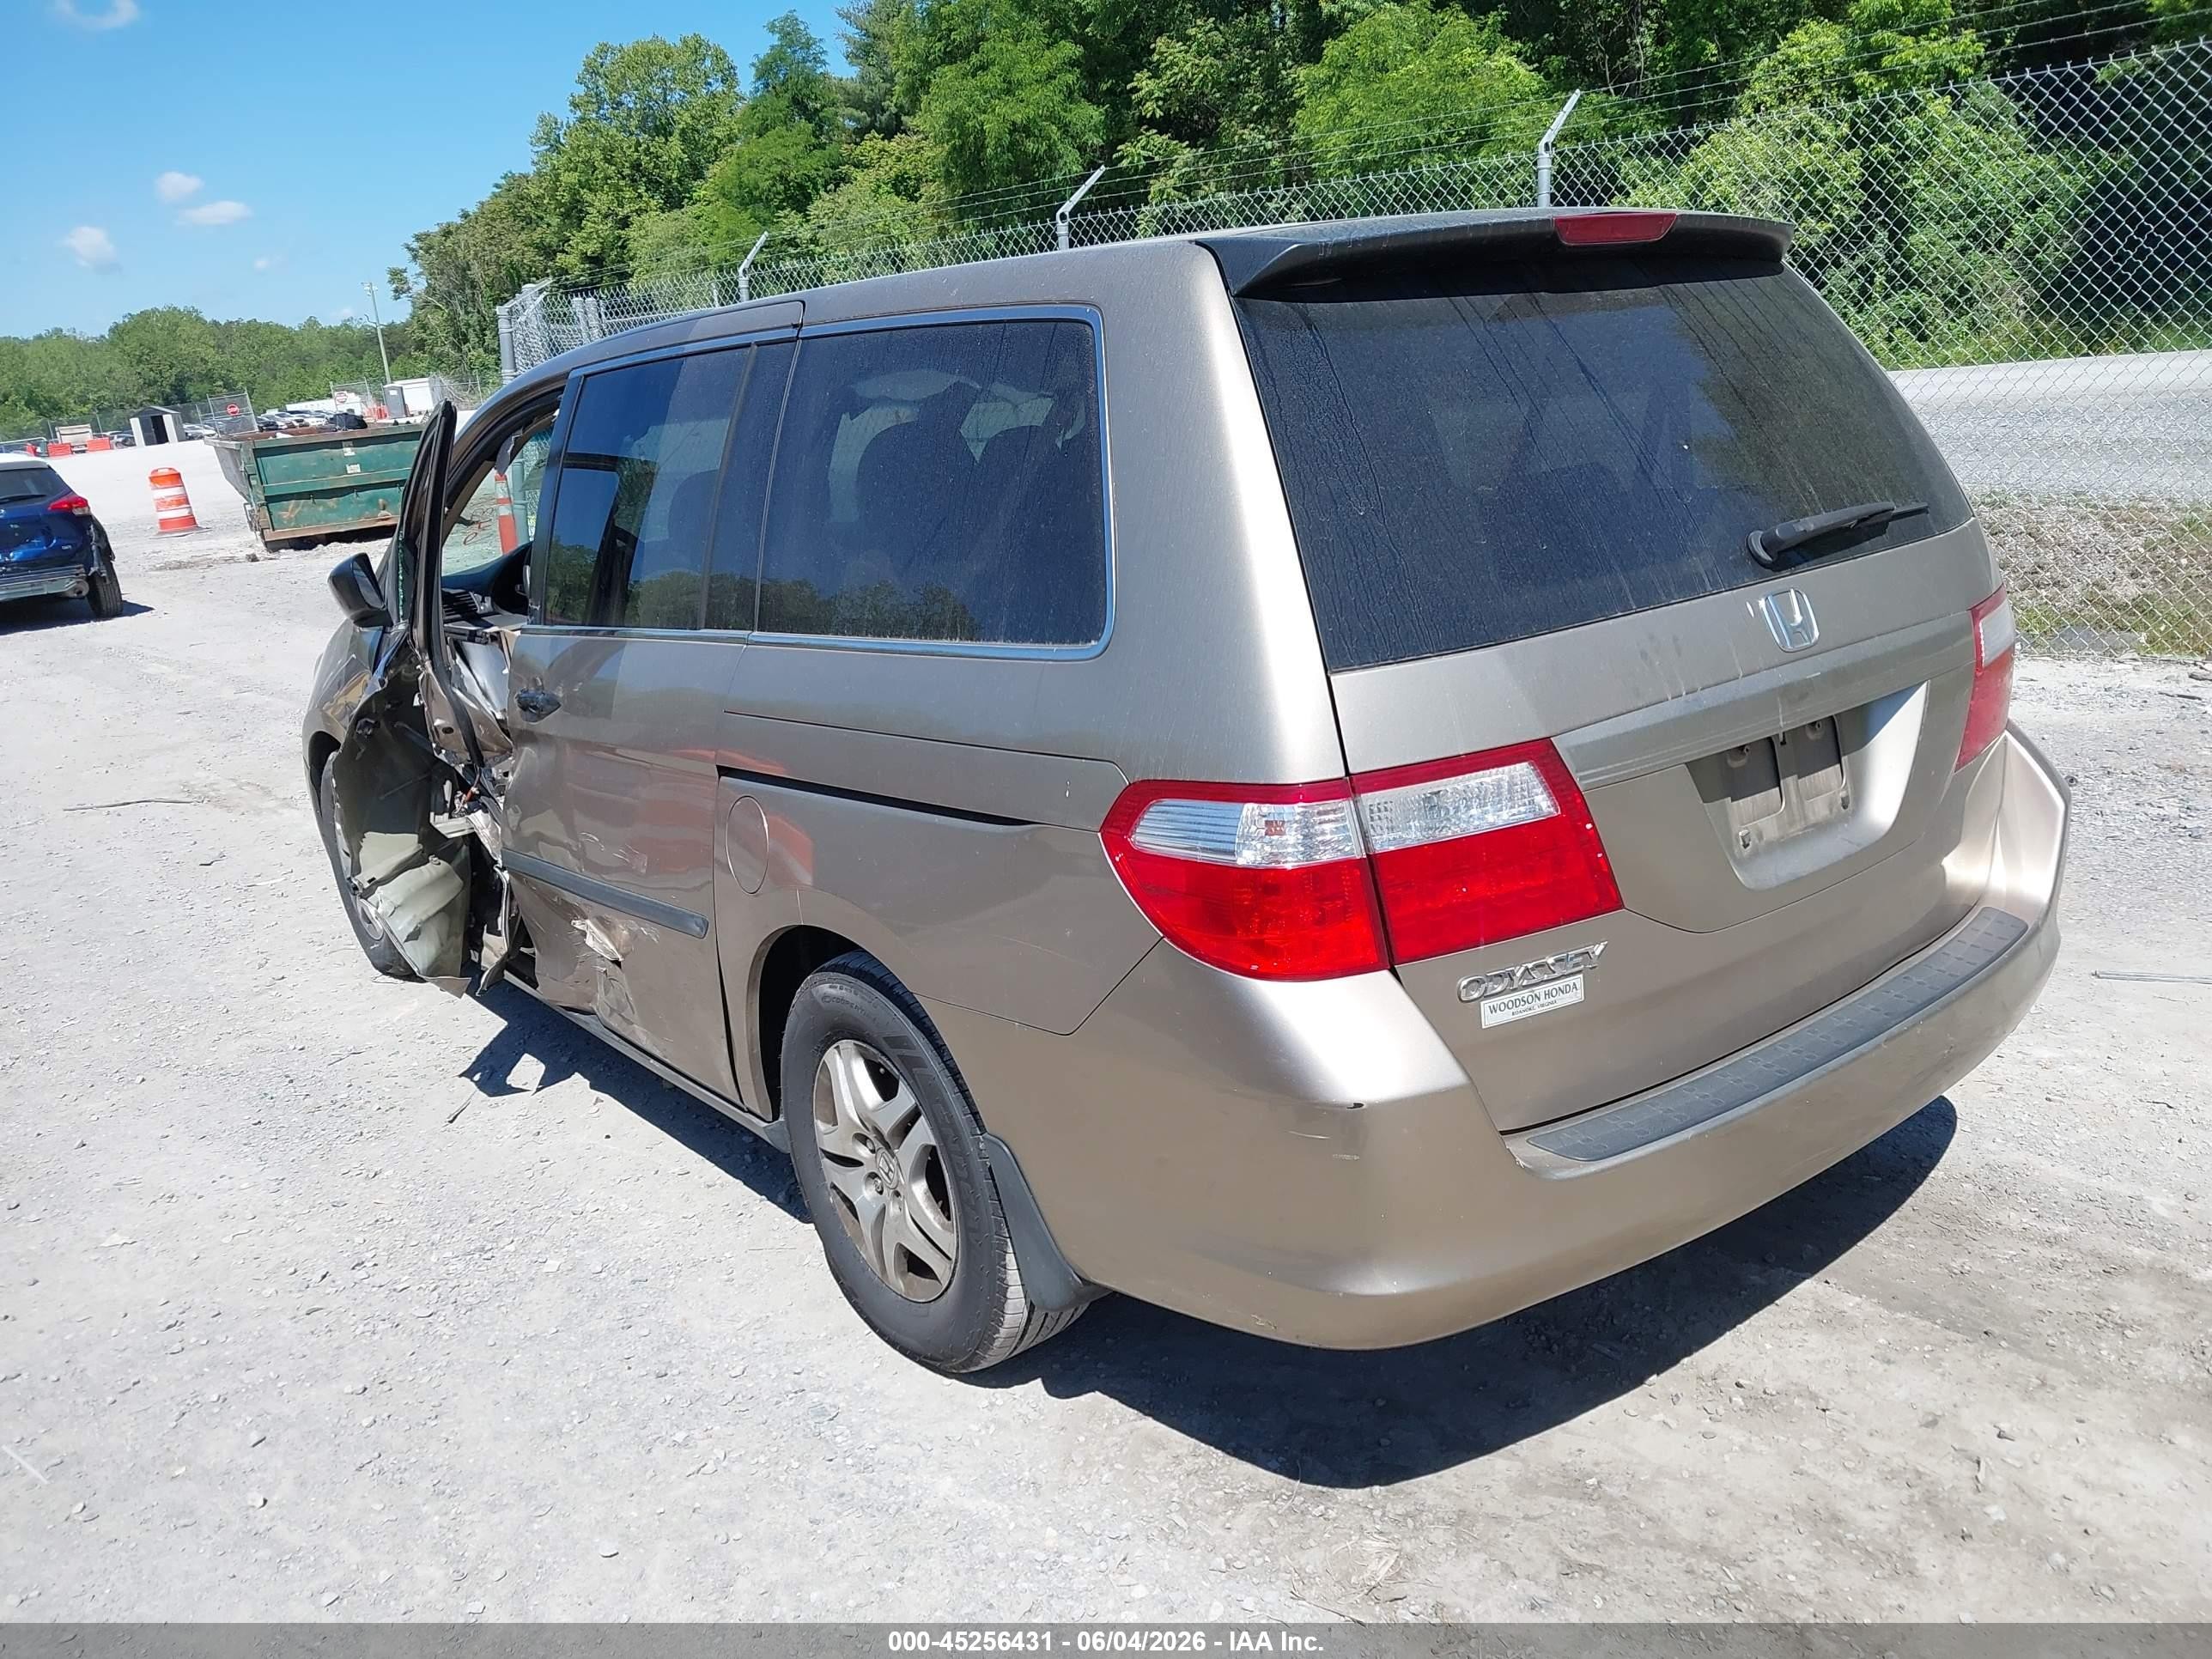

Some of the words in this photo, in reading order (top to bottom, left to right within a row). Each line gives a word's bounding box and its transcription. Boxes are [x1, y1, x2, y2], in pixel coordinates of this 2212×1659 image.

[1457, 941, 1607, 1002] ODYSSEY
[1488, 992, 1541, 1015] WOODSON
[1544, 981, 1578, 1000] HONDA
